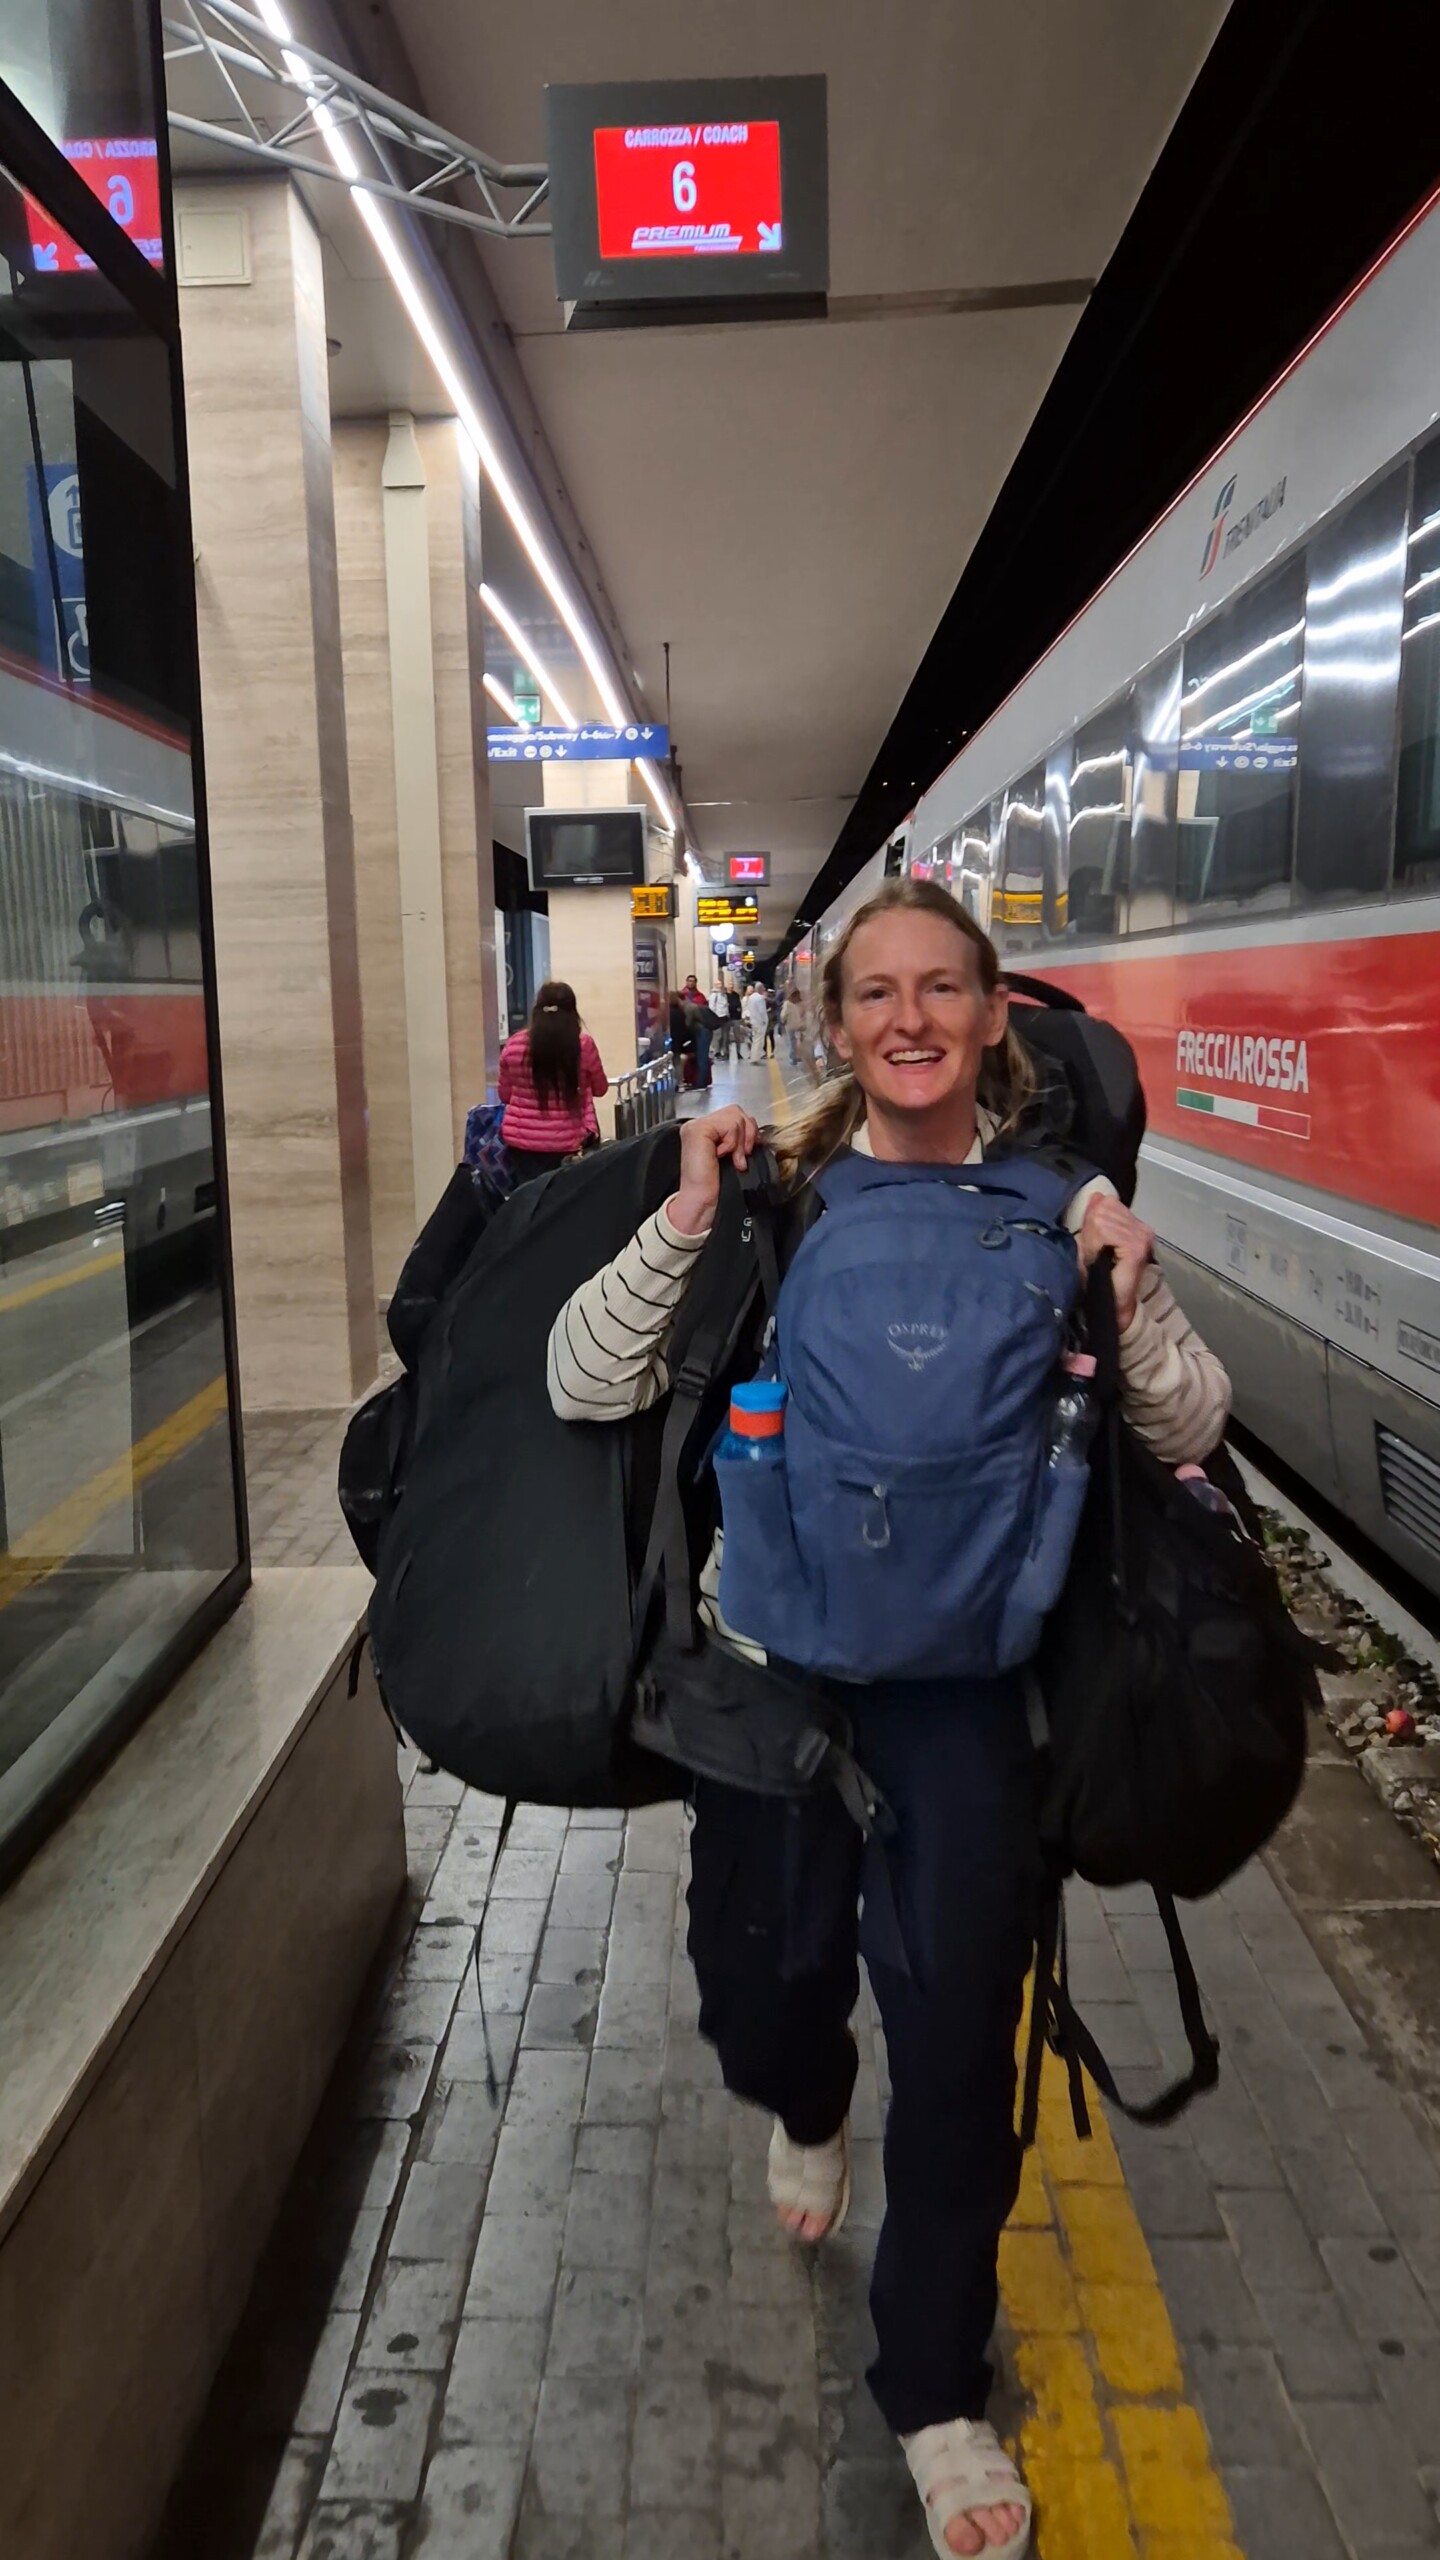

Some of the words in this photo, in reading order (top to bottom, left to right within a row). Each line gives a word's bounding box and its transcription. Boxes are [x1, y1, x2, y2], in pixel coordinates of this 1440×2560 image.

[625, 128, 691, 148] CARROZZA
[703, 125, 748, 144] COACH
[673, 161, 697, 212] 6
[633, 223, 731, 241] PREMIUM
[1176, 1030, 1309, 1093] FRECCIAROSSA
